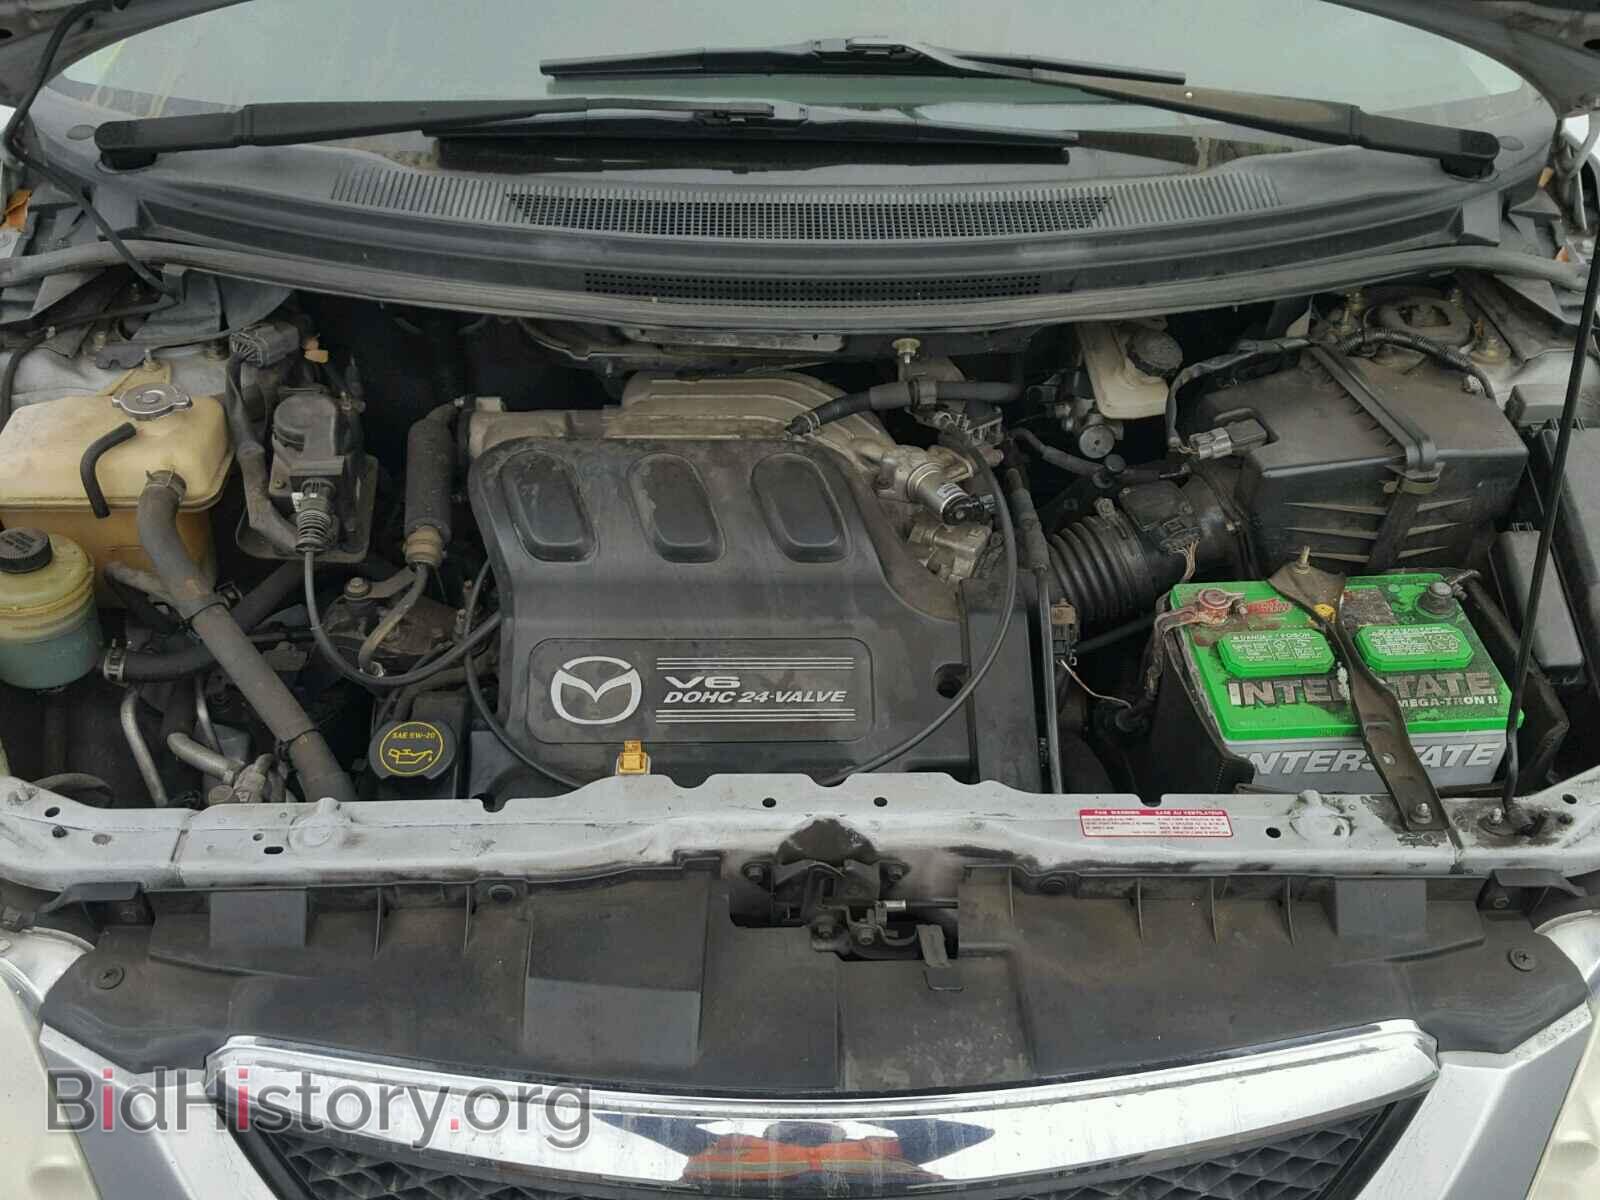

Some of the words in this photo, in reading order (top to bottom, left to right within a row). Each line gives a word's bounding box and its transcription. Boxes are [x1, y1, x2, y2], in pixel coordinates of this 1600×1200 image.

[664, 676, 741, 689] V6
[1228, 672, 1496, 705] INTETATE
[663, 691, 737, 704] DOHC
[737, 690, 848, 703] 24-VALVE
